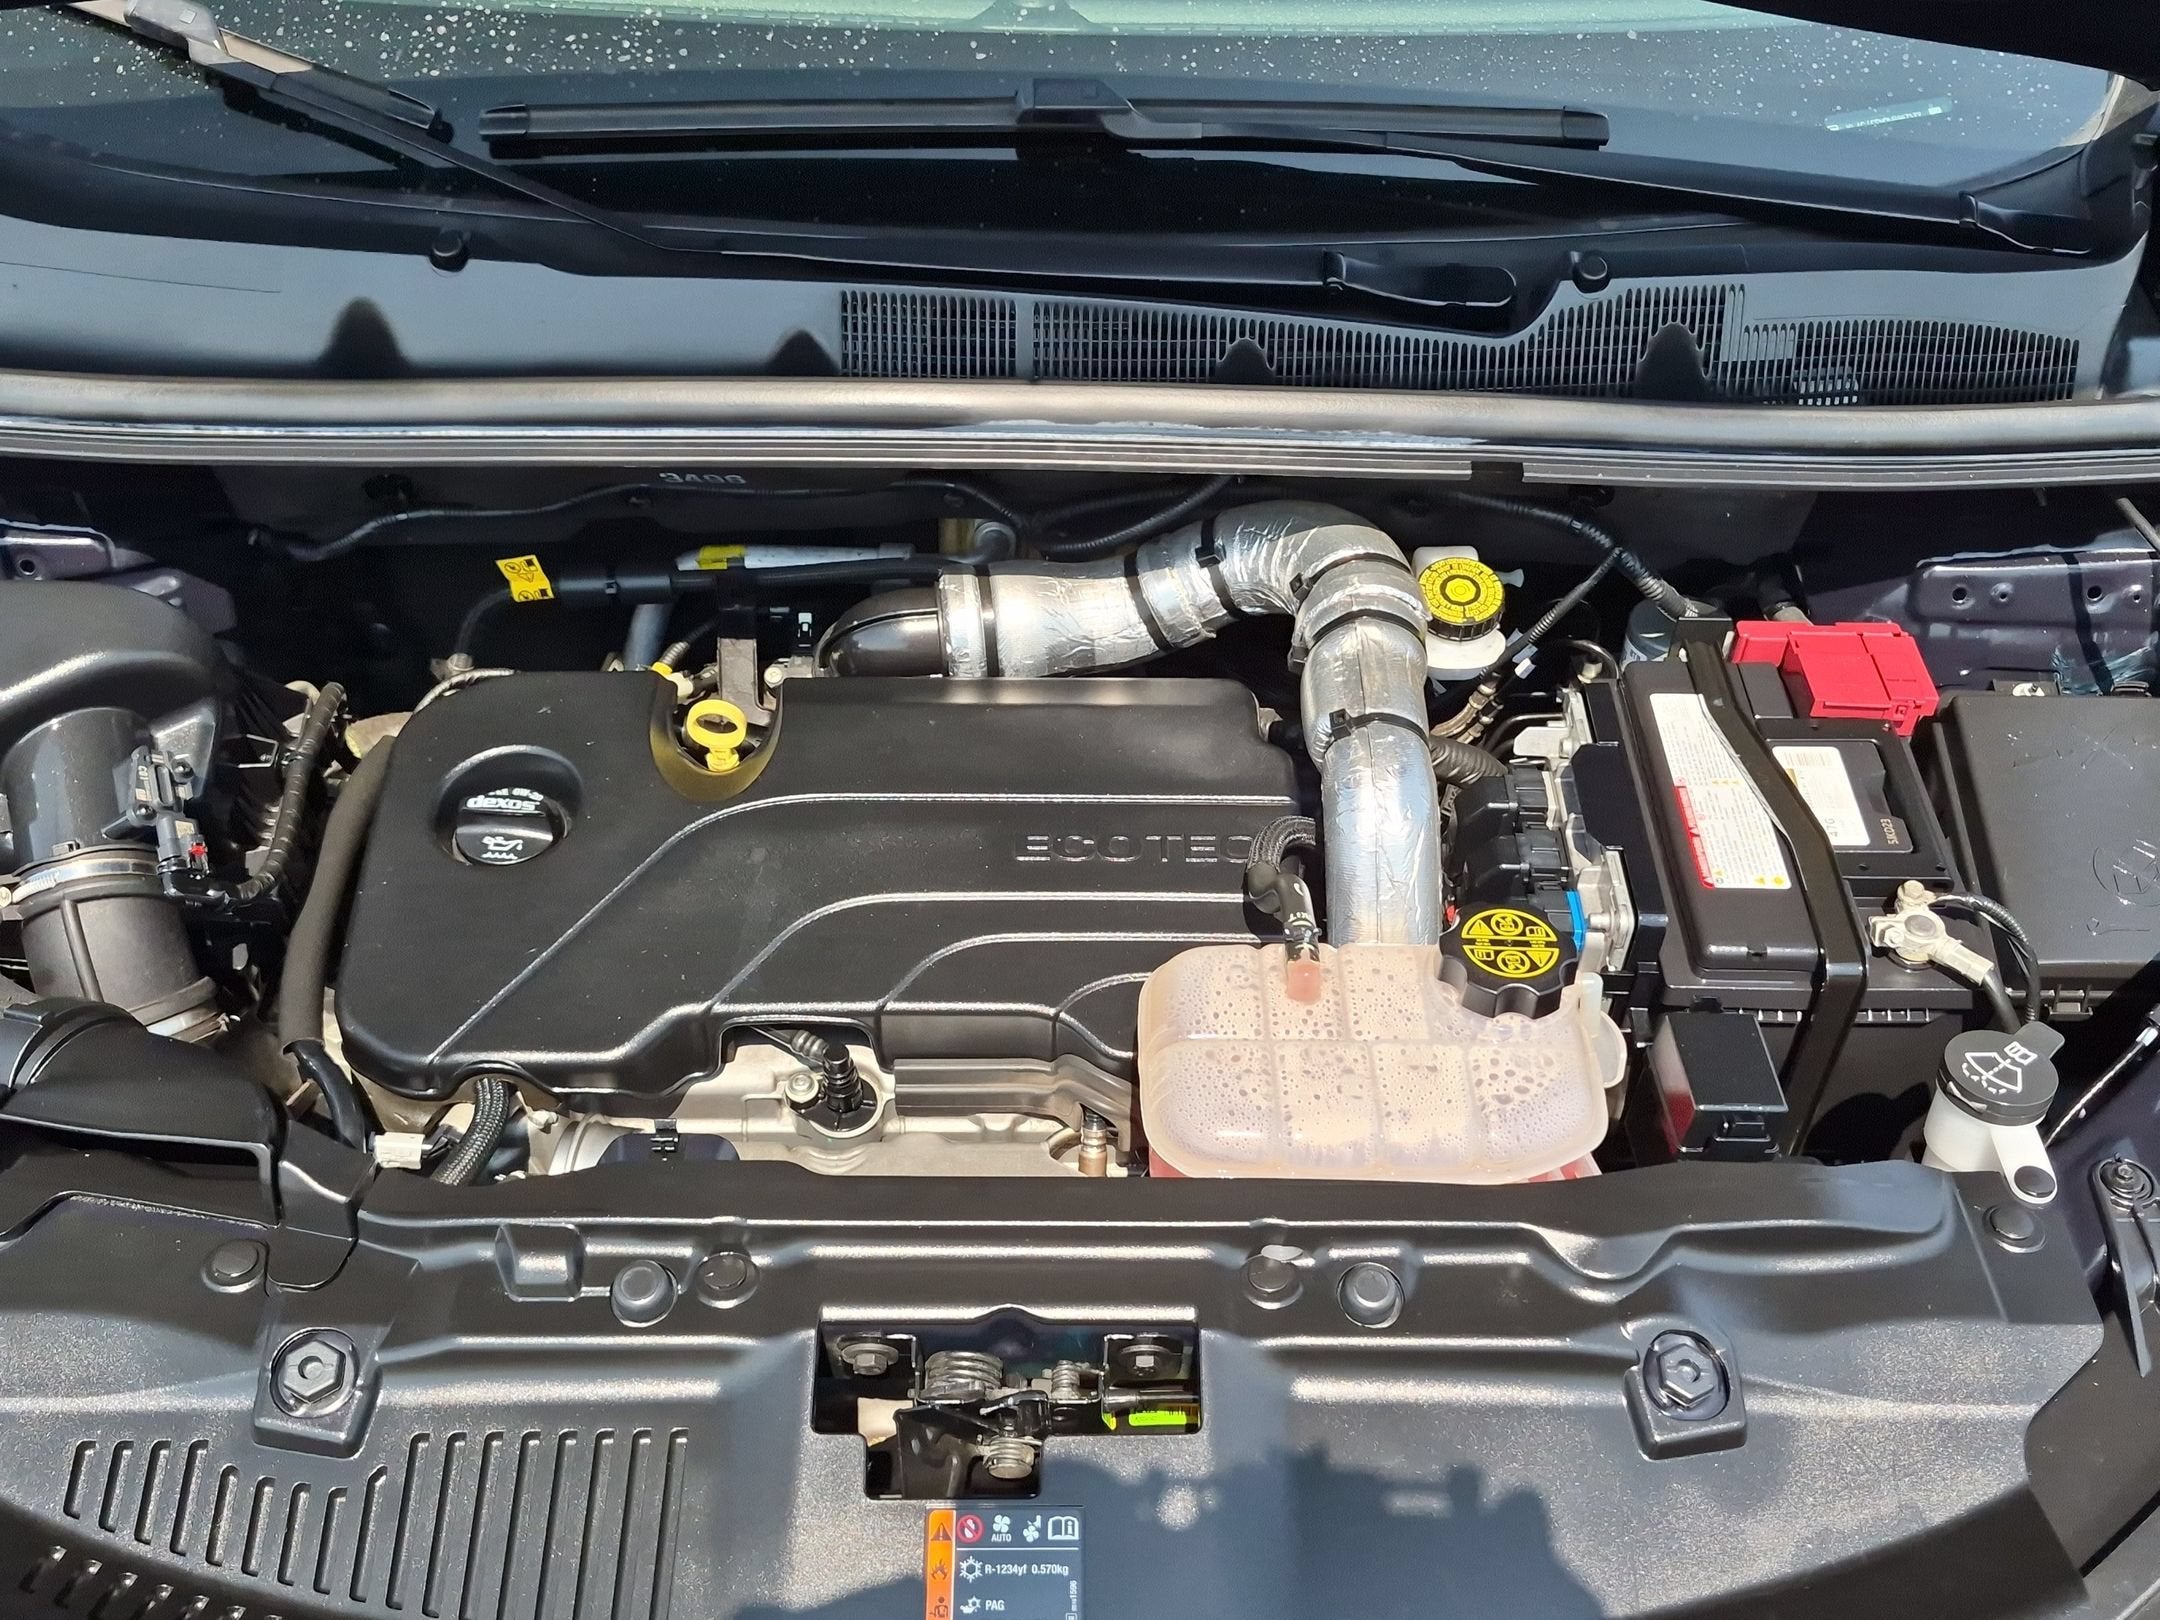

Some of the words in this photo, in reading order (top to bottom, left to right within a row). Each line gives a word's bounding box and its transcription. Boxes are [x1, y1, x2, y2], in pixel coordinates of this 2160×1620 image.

[466, 795, 541, 811] dexos
[1014, 834, 1254, 864] ECOTEC
[991, 1533, 1012, 1542] AUTO
[984, 1564, 1028, 1576] R-1234yf
[1031, 1564, 1069, 1577] 0.570kg
[985, 1600, 1006, 1611] PAG
